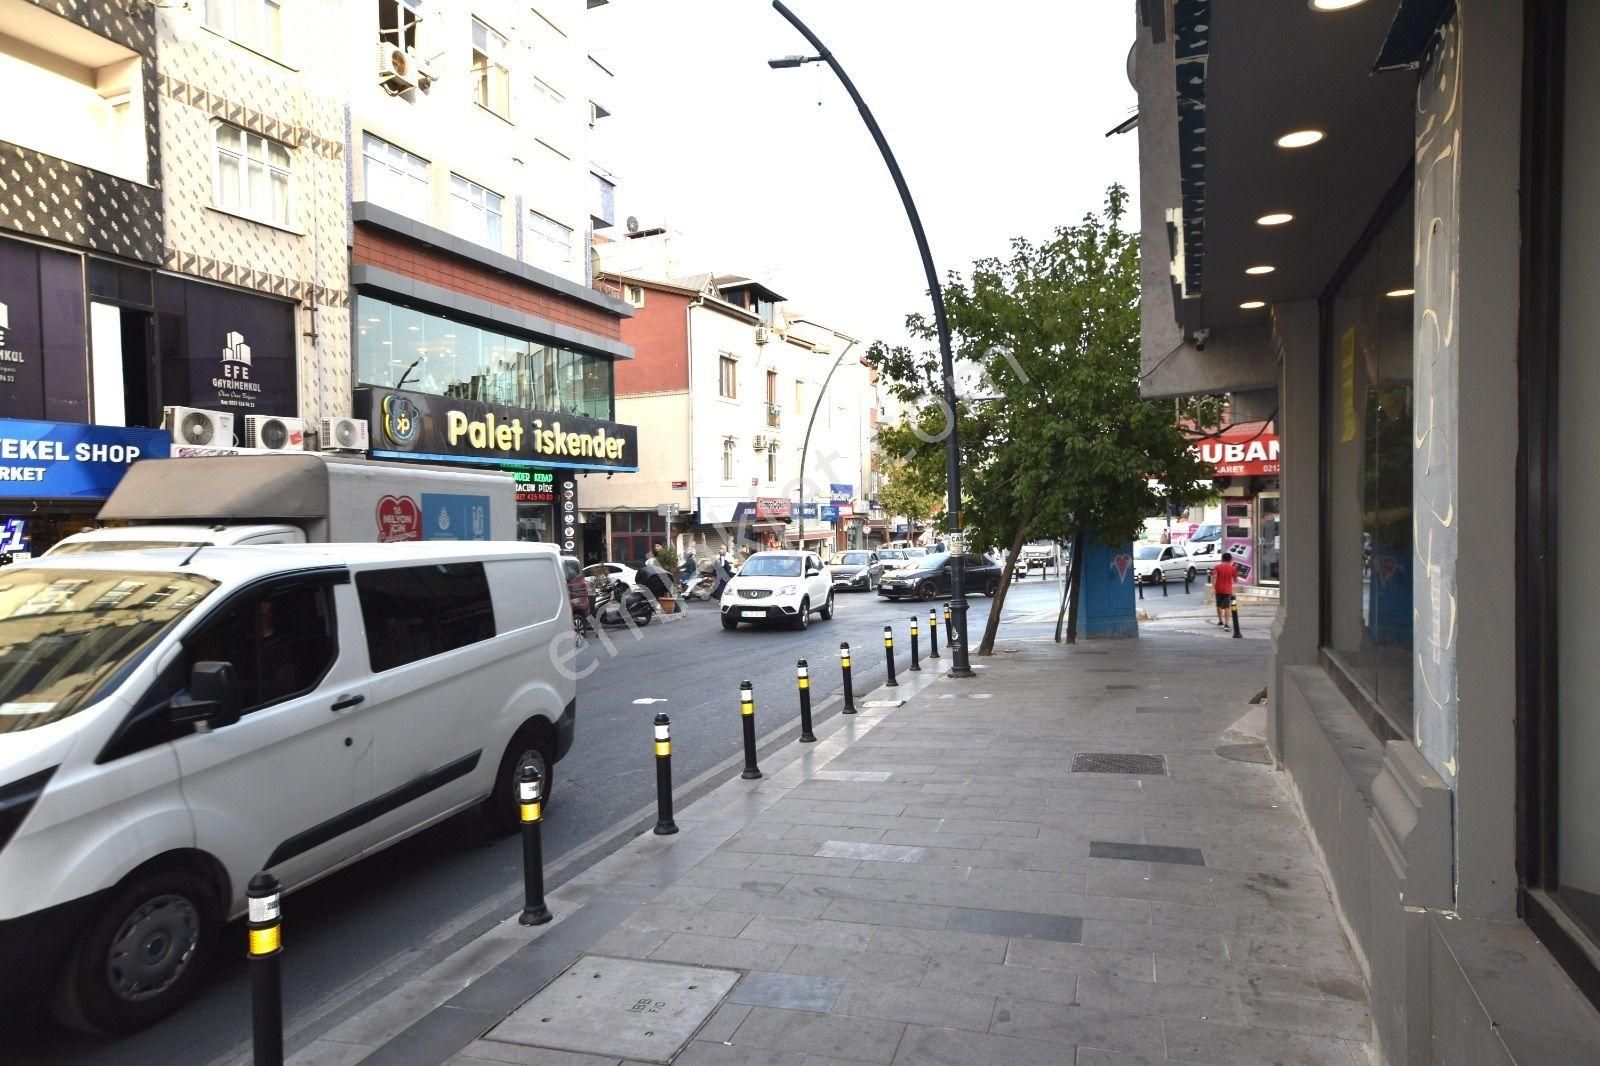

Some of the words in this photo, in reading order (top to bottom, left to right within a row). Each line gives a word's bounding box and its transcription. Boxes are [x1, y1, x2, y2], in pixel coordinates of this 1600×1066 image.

[224, 364, 249, 380] EFE
[447, 410, 524, 451] Palet
[532, 418, 626, 460] iskender
[0, 438, 70, 461] EKEL
[75, 442, 141, 463] SHOP
